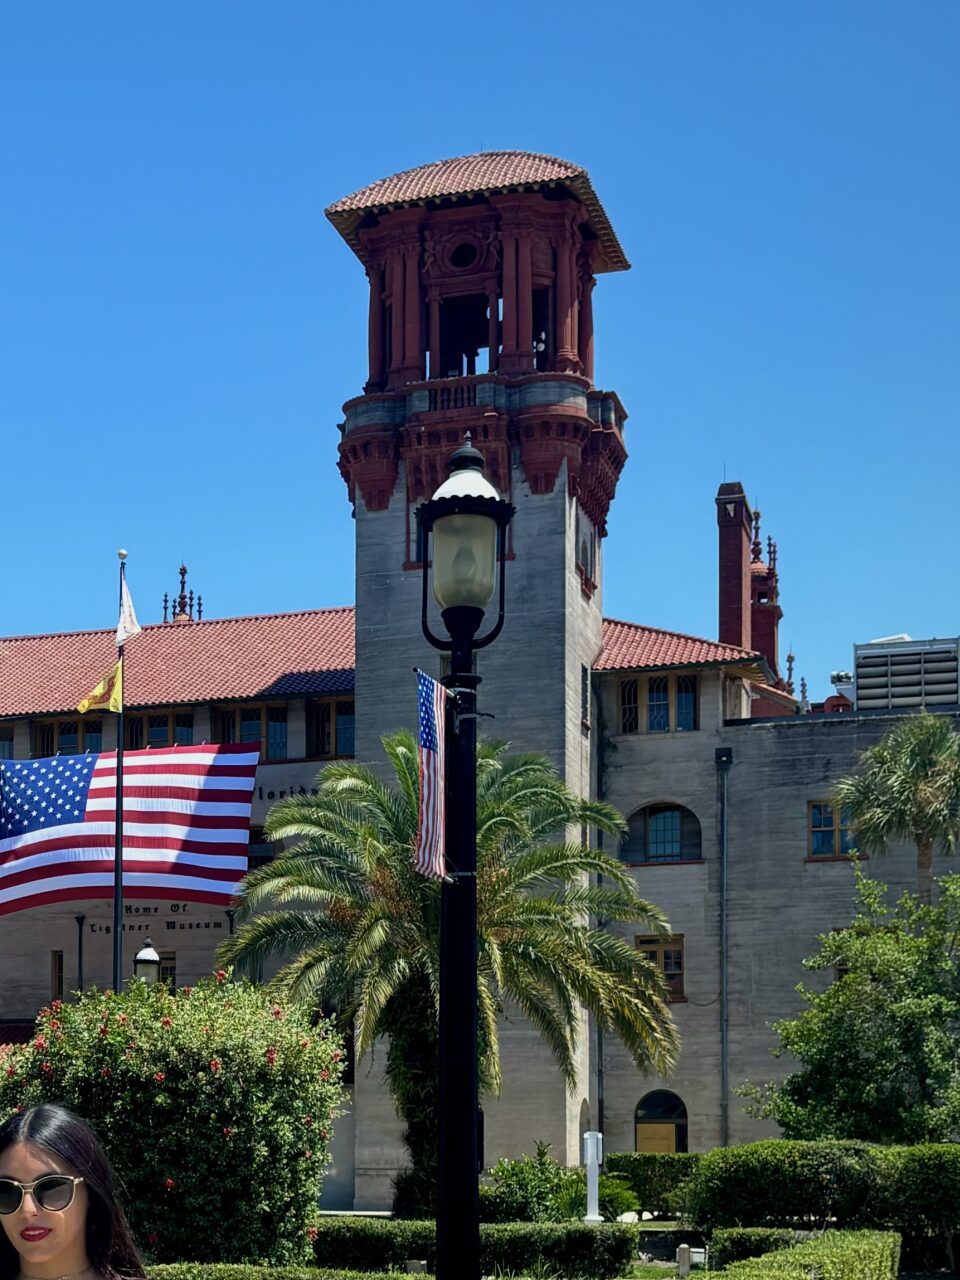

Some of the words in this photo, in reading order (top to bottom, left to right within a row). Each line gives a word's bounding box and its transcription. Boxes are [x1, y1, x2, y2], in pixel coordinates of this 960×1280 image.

[258, 785, 319, 800] lorida
[124, 905, 159, 914] Home
[170, 903, 187, 912] Of
[89, 923, 151, 934] Ligtner
[165, 921, 222, 930] Museum
